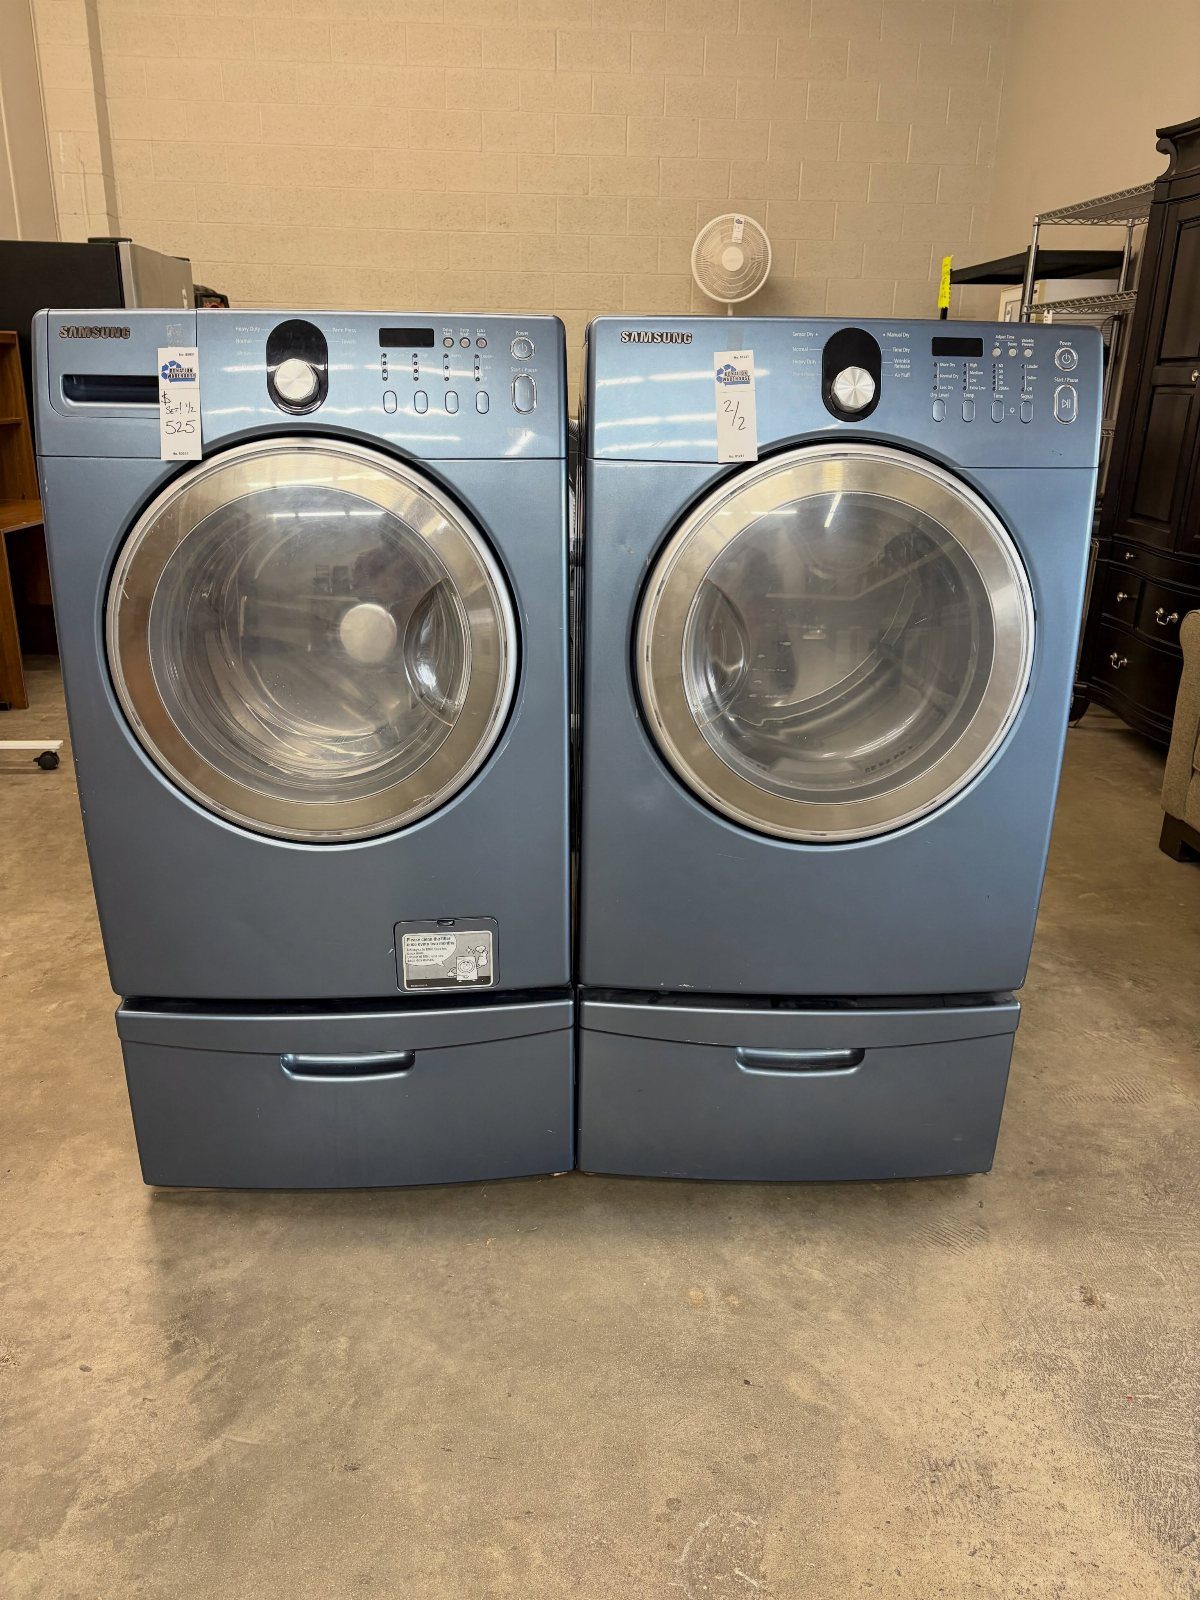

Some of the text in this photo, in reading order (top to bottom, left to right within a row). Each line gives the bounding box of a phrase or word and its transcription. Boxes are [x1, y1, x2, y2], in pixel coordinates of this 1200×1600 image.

[59, 326, 131, 339] SAMSUNG
[621, 330, 693, 344] SAMSUNG
[723, 400, 746, 430] 2/2
[165, 420, 196, 434] 525
